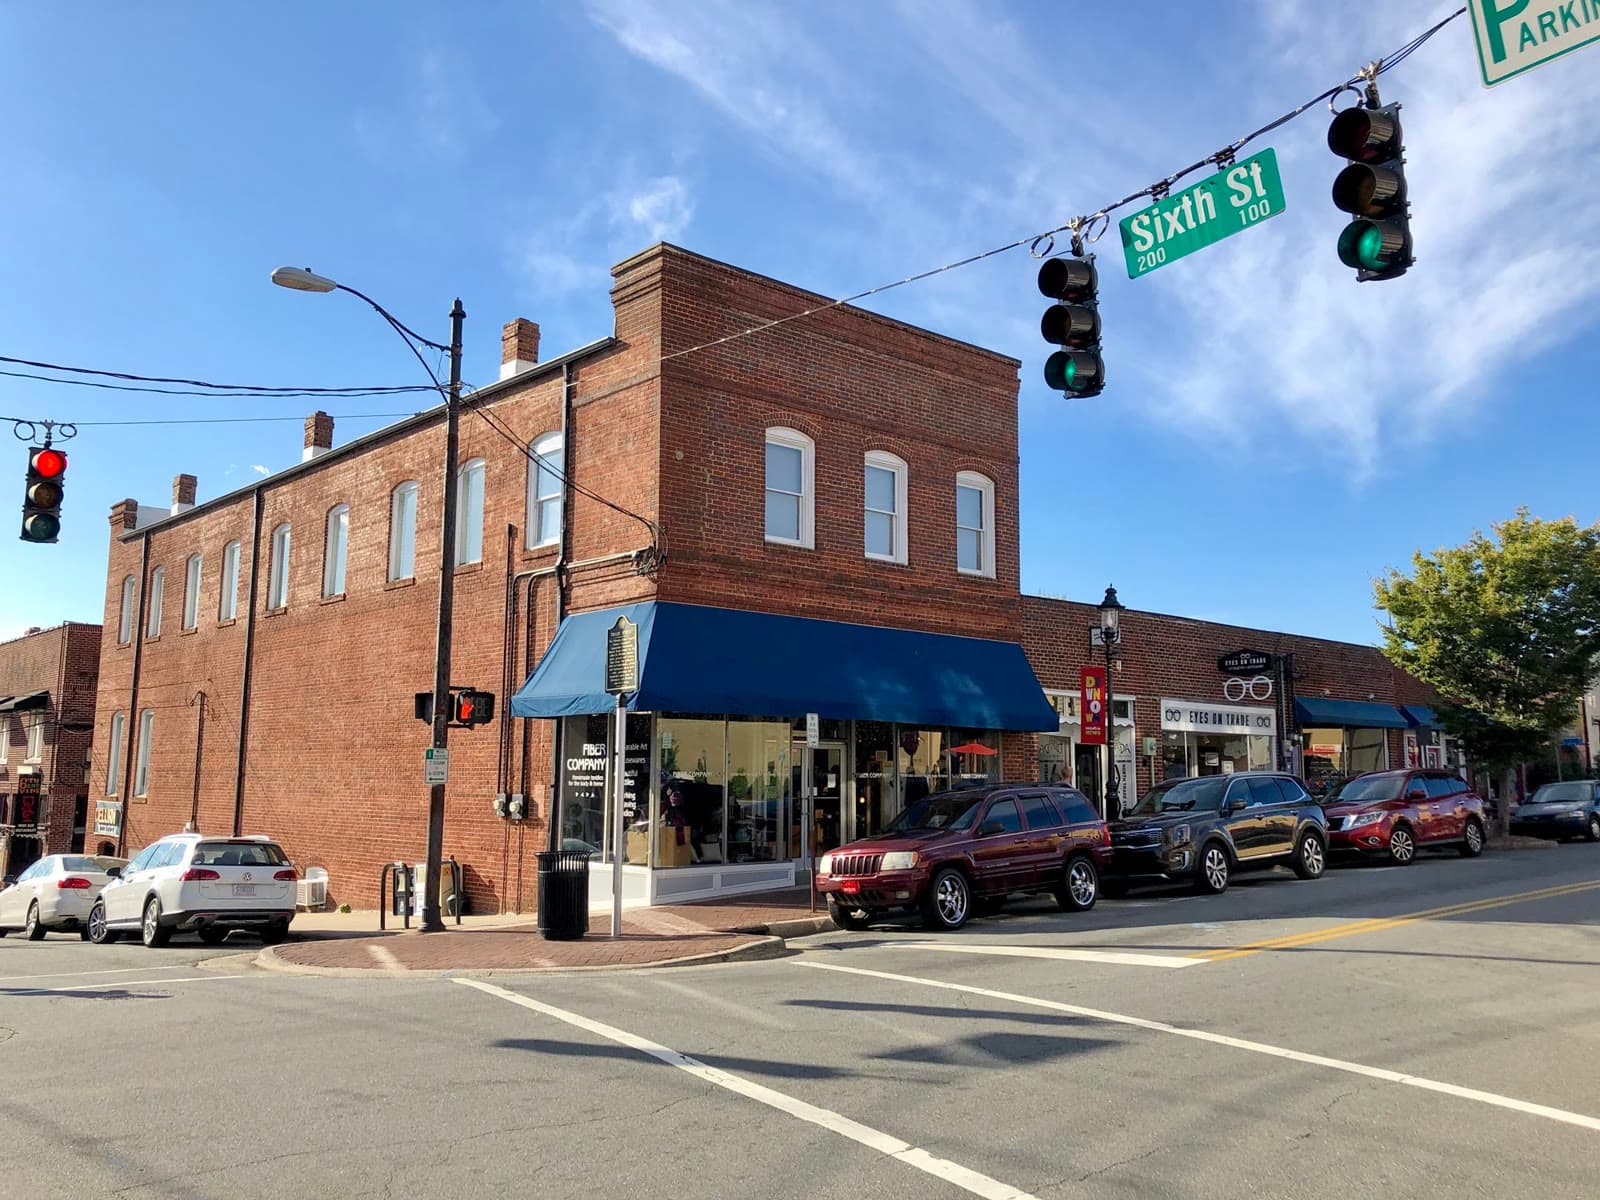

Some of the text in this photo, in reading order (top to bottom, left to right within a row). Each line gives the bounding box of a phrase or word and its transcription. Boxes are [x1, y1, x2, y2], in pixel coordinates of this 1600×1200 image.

[1131, 162, 1267, 252] Sixth St
[1137, 199, 1271, 273] 200 100
[1225, 659, 1239, 667] EYES
[1189, 711, 1250, 727] EYES ON TRADE
[582, 743, 606, 757] FIBER
[566, 758, 606, 771] COMPANY
